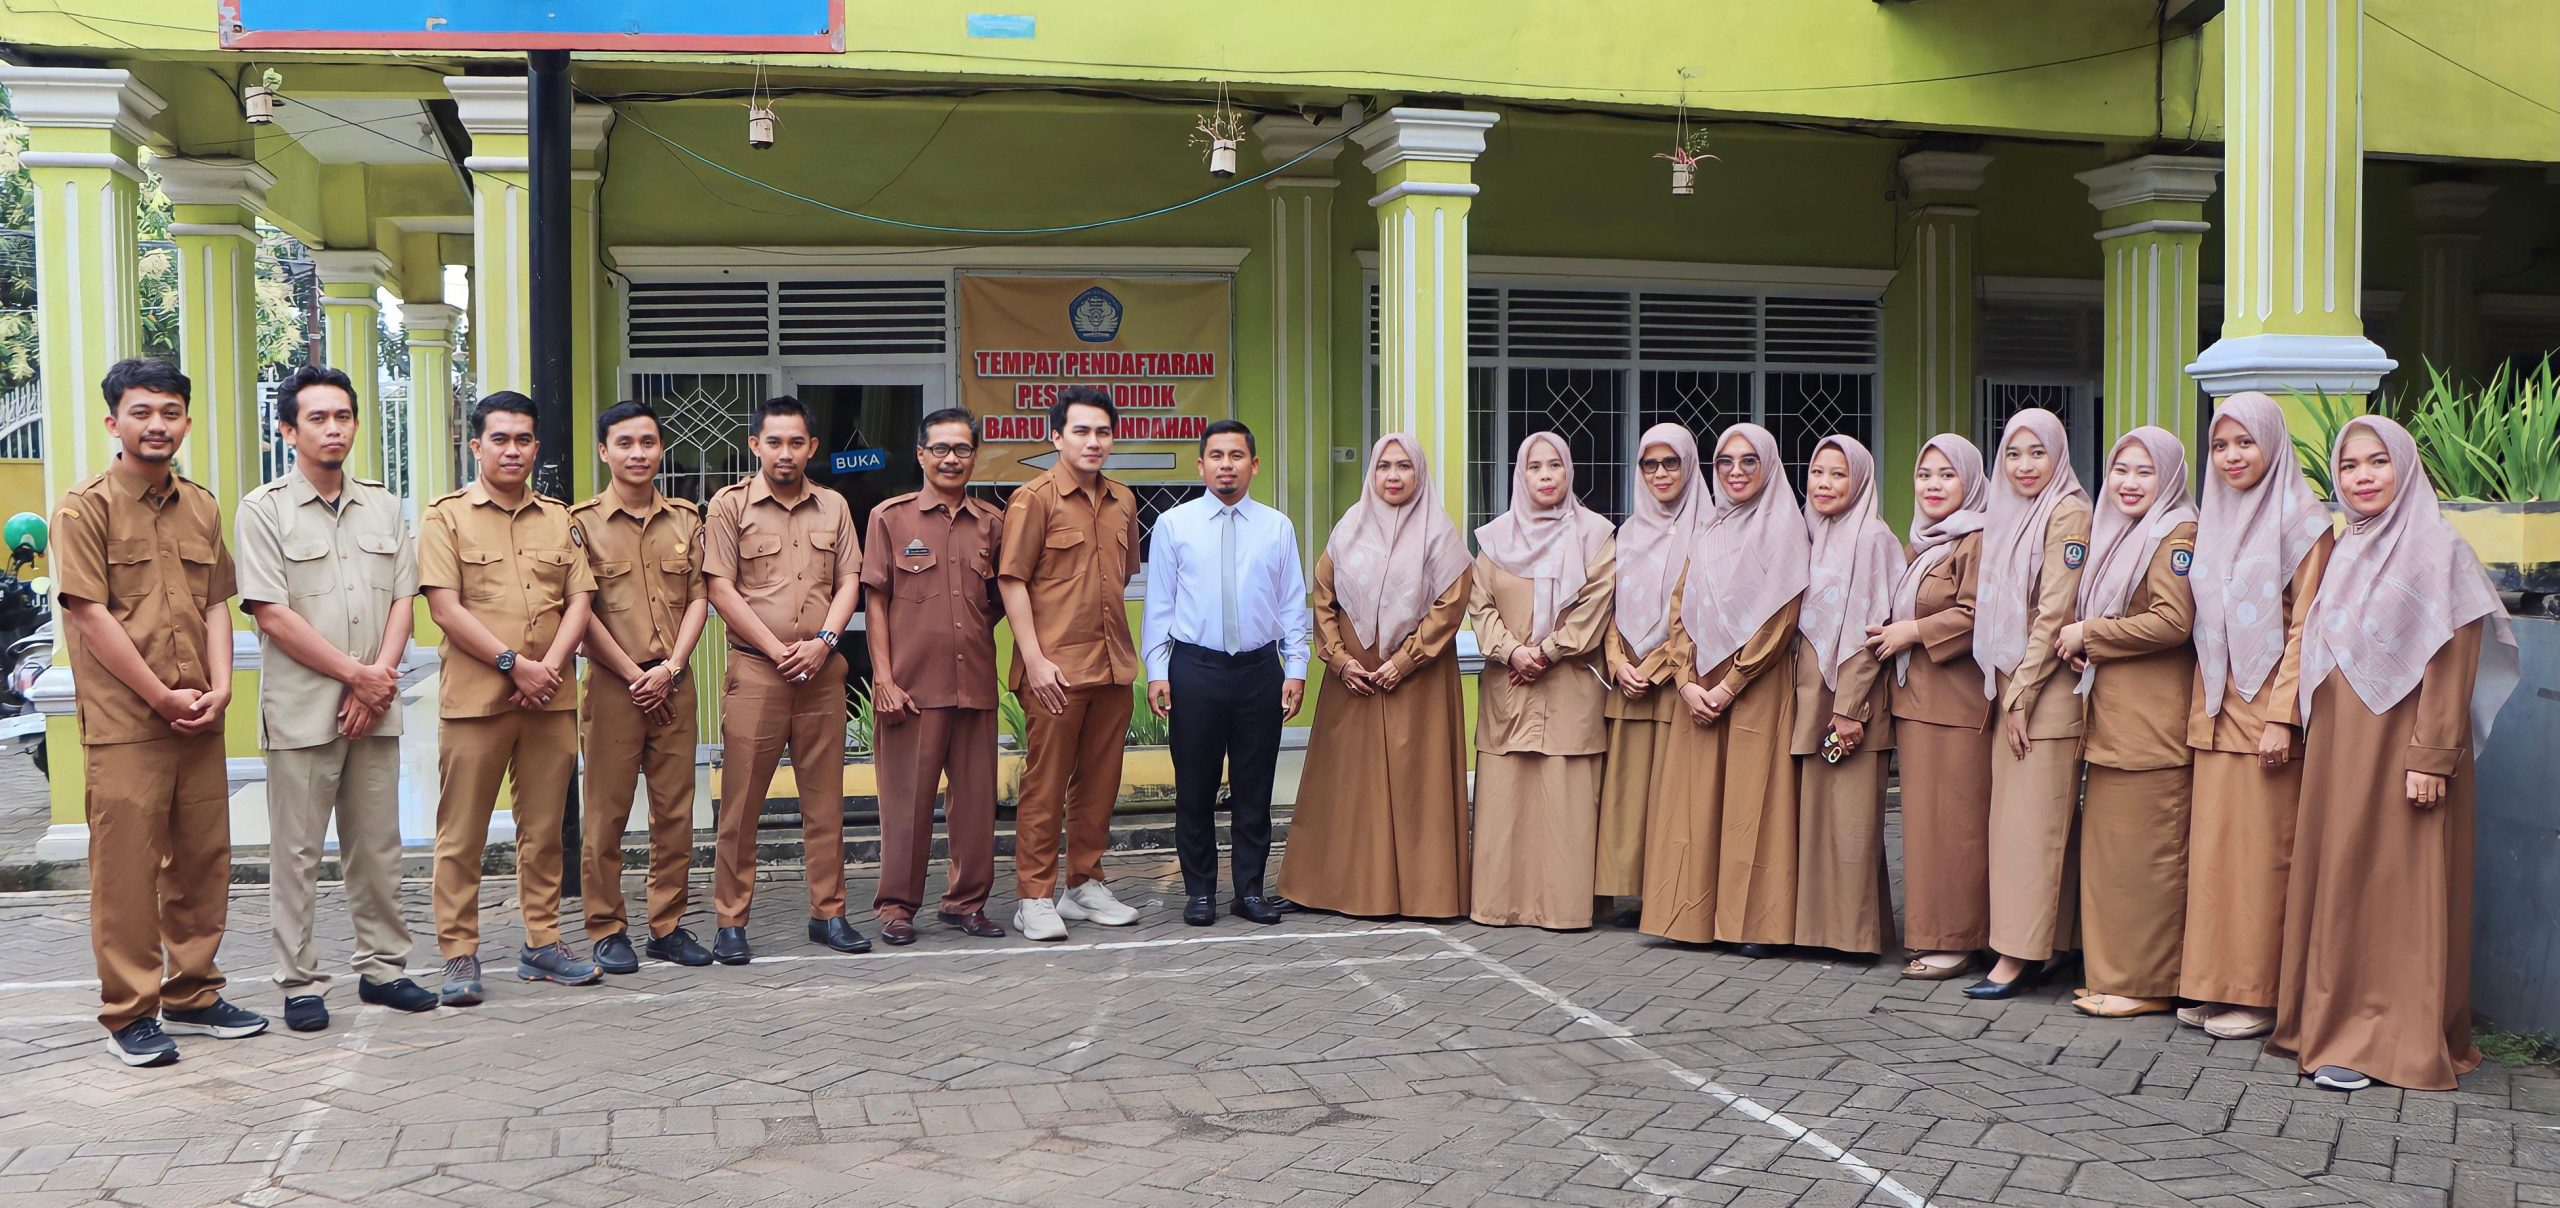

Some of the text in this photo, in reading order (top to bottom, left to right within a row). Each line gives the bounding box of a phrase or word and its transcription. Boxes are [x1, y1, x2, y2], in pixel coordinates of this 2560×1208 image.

[975, 351, 1215, 377] TEMPAT PENDAFTARAN
[1113, 383, 1176, 409] DIDIK
[983, 415, 1046, 442] BARU
[1113, 415, 1208, 441] INDAHAN
[836, 454, 880, 469] BUKA
